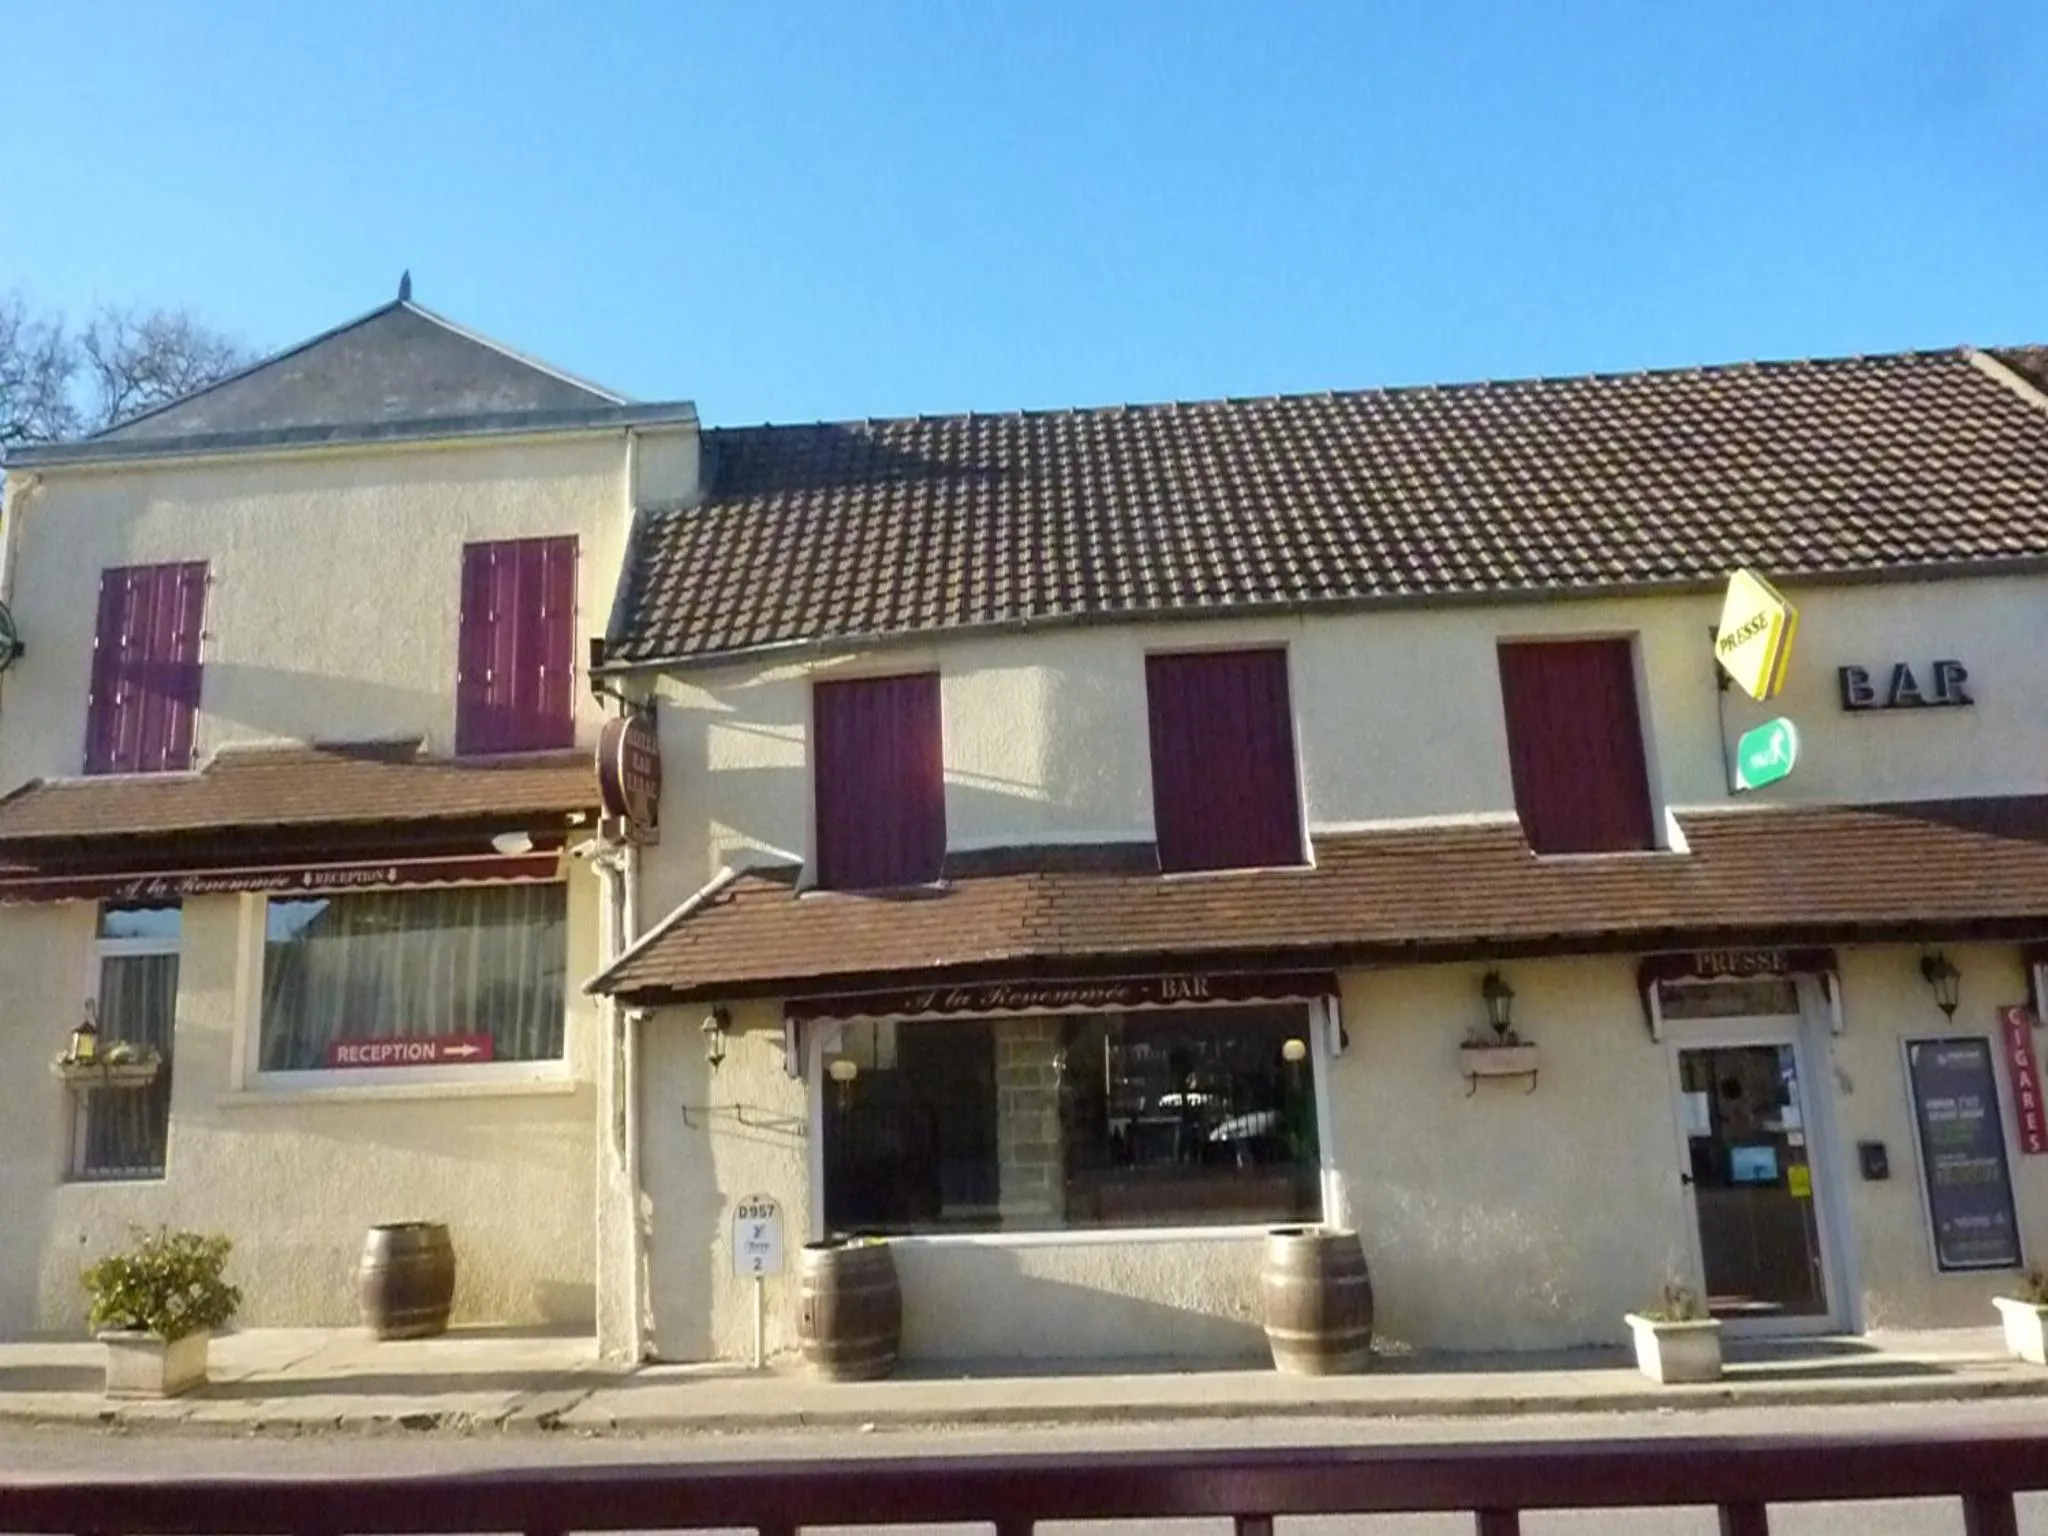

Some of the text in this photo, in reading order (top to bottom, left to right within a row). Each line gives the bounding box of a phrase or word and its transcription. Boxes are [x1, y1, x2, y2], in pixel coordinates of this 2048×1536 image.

[1719, 610, 1769, 656] PRESSE
[1838, 660, 1975, 711] BAR
[147, 876, 167, 895] la
[315, 868, 385, 885] RECEPTION
[1695, 949, 1789, 974] PRESSE
[944, 985, 968, 1007] la
[1161, 976, 1210, 998] BAR
[337, 1042, 436, 1062] RECEPTION
[2008, 1008, 2041, 1152] CIGARES
